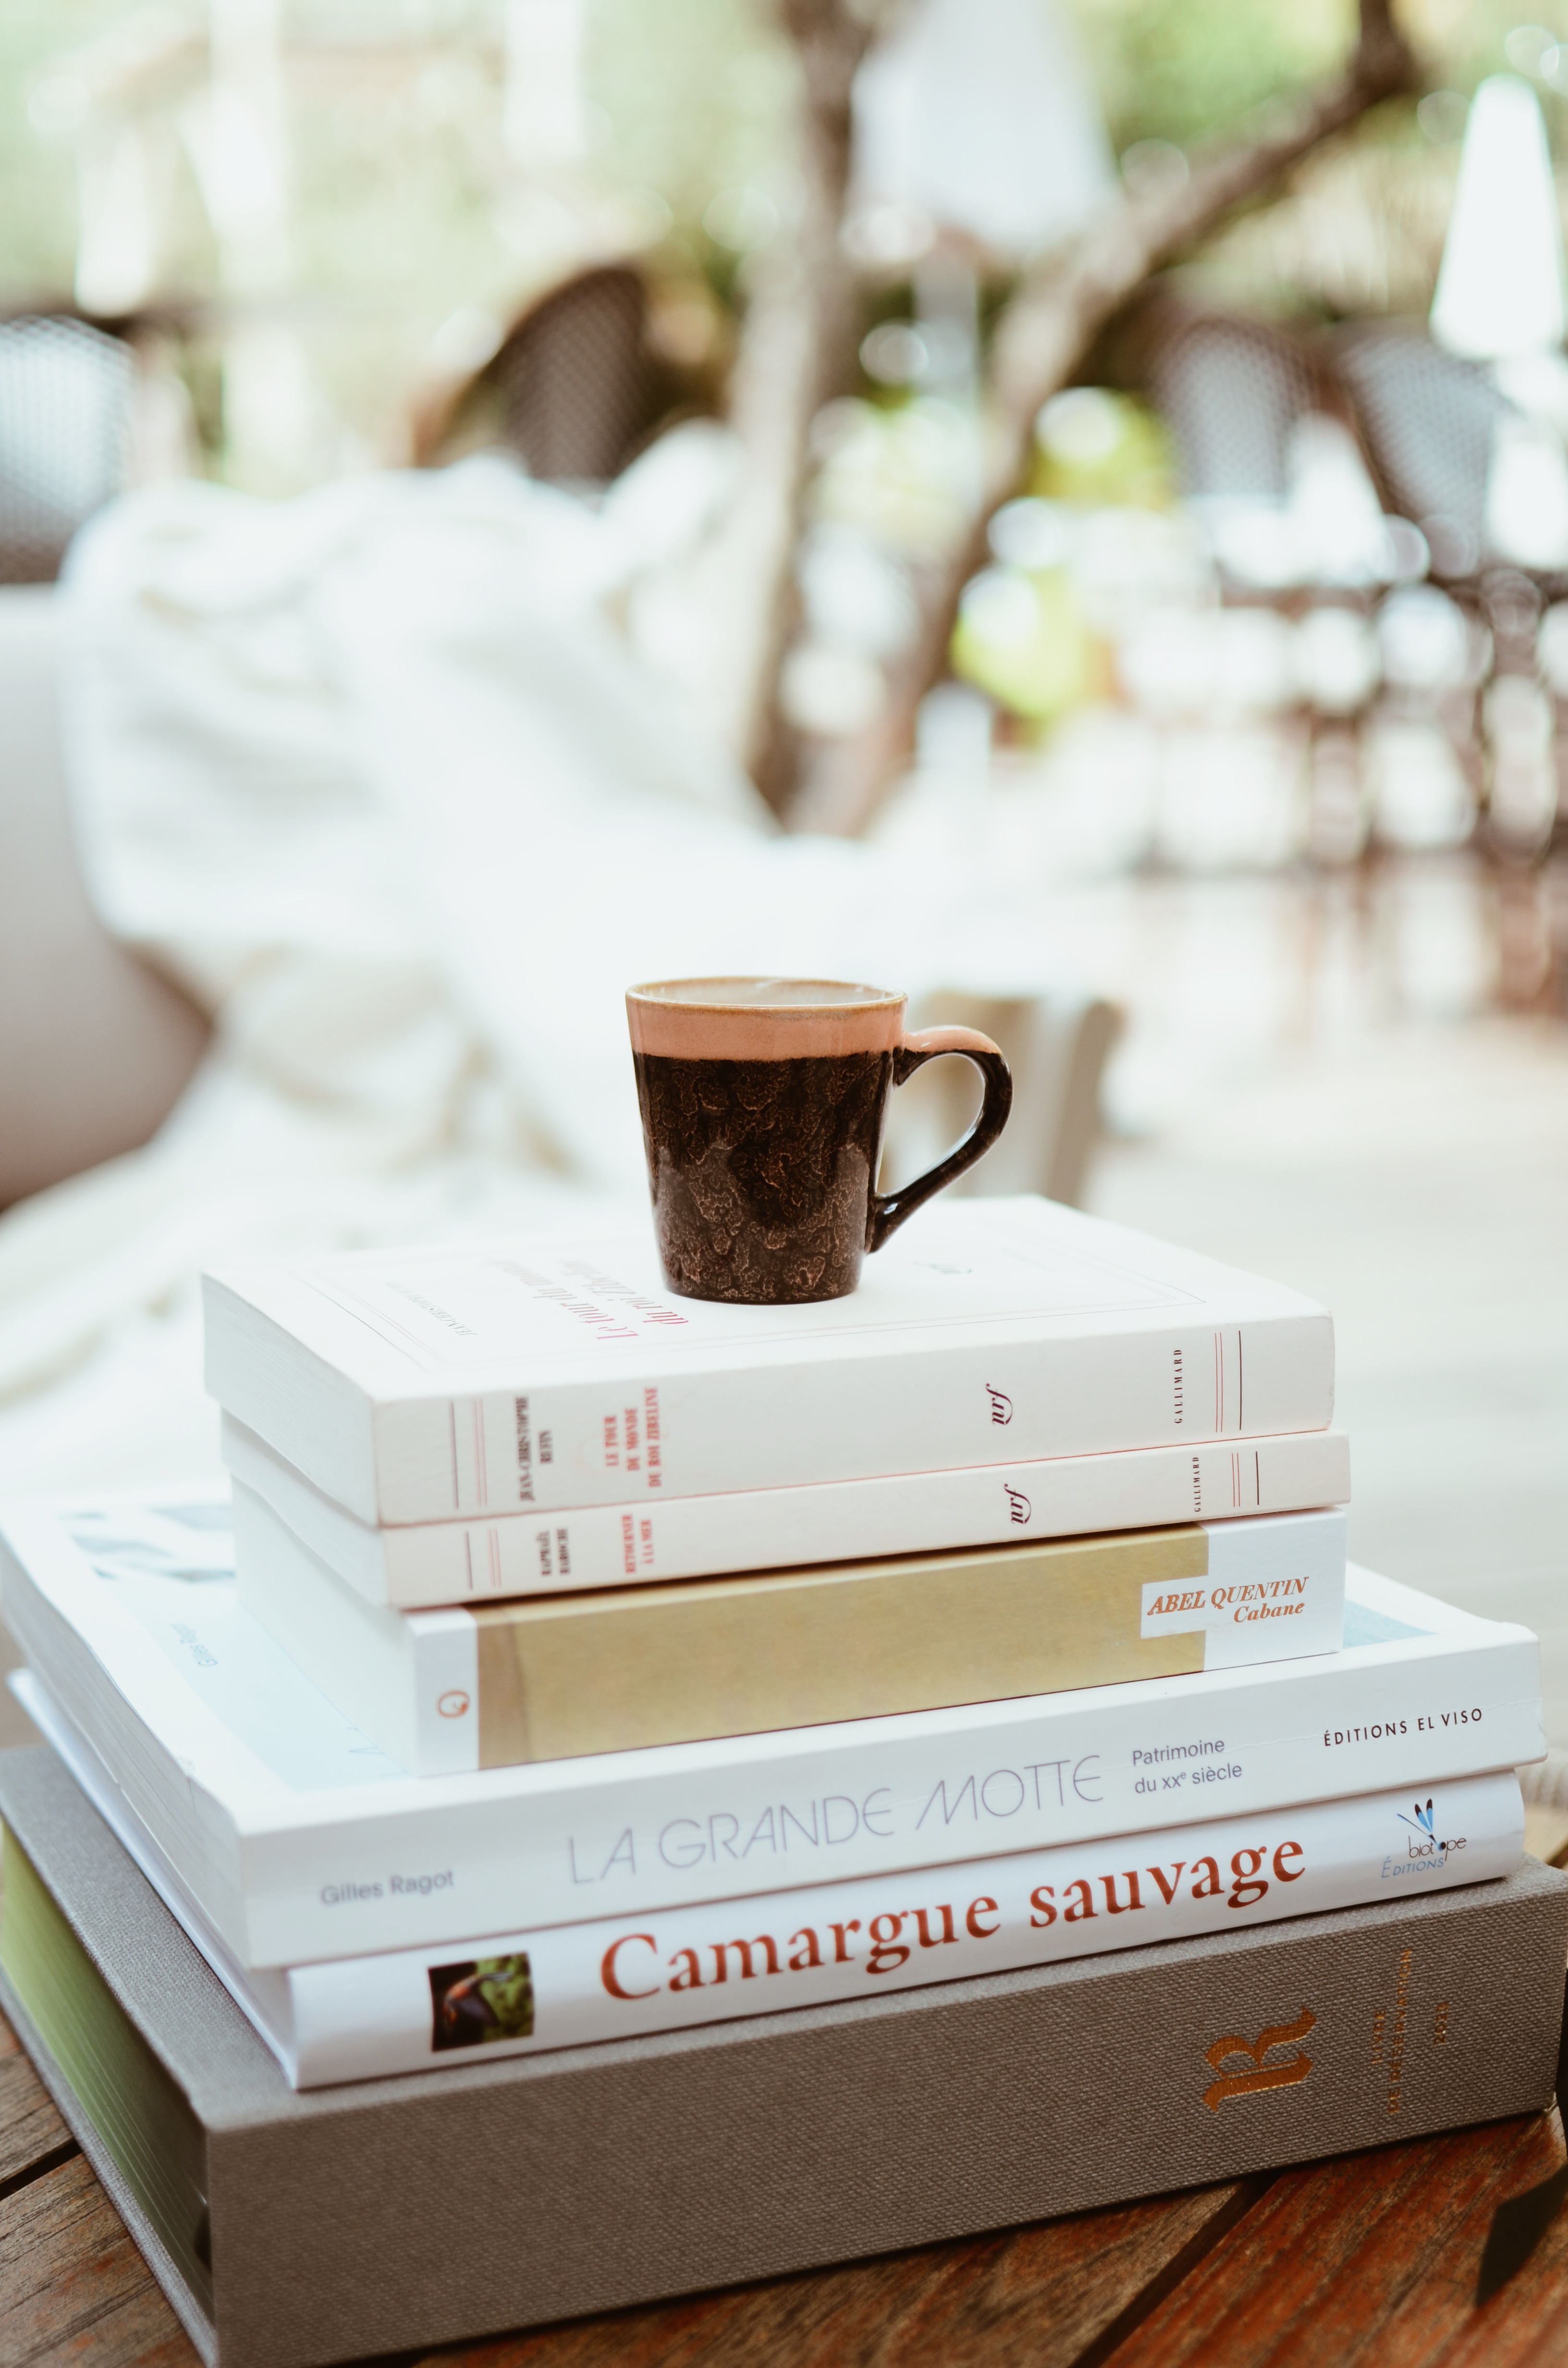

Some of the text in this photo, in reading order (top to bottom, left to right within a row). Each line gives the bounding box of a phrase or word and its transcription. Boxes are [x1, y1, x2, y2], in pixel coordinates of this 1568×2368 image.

[559, 1303, 615, 1323] tour
[596, 1325, 639, 1340] Le
[986, 1383, 1013, 1425] nrf
[1174, 1349, 1183, 1424] GALLIMARD
[604, 1416, 619, 1466] LE TOUR
[625, 1409, 638, 1450] MONDE
[648, 1446, 661, 1467] ROI
[1004, 1483, 1031, 1524] nrf
[1192, 1457, 1201, 1512] GALLIMARD
[1147, 1577, 1310, 1616] ABEL QUENTIN
[1234, 1603, 1305, 1623] Cabane
[1324, 1709, 1482, 1746] ÉDITIONS EL VISO
[1133, 1740, 1225, 1766] Patrimoine
[1135, 1777, 1157, 1793] du
[1192, 1764, 1242, 1784] siècle
[569, 1755, 1103, 1884] LA GRANDE MOTTE
[320, 1870, 454, 1906] Gilles Ragot
[600, 1841, 1306, 2001] Camargue sauvage
[1387, 2088, 1401, 2114] DE
